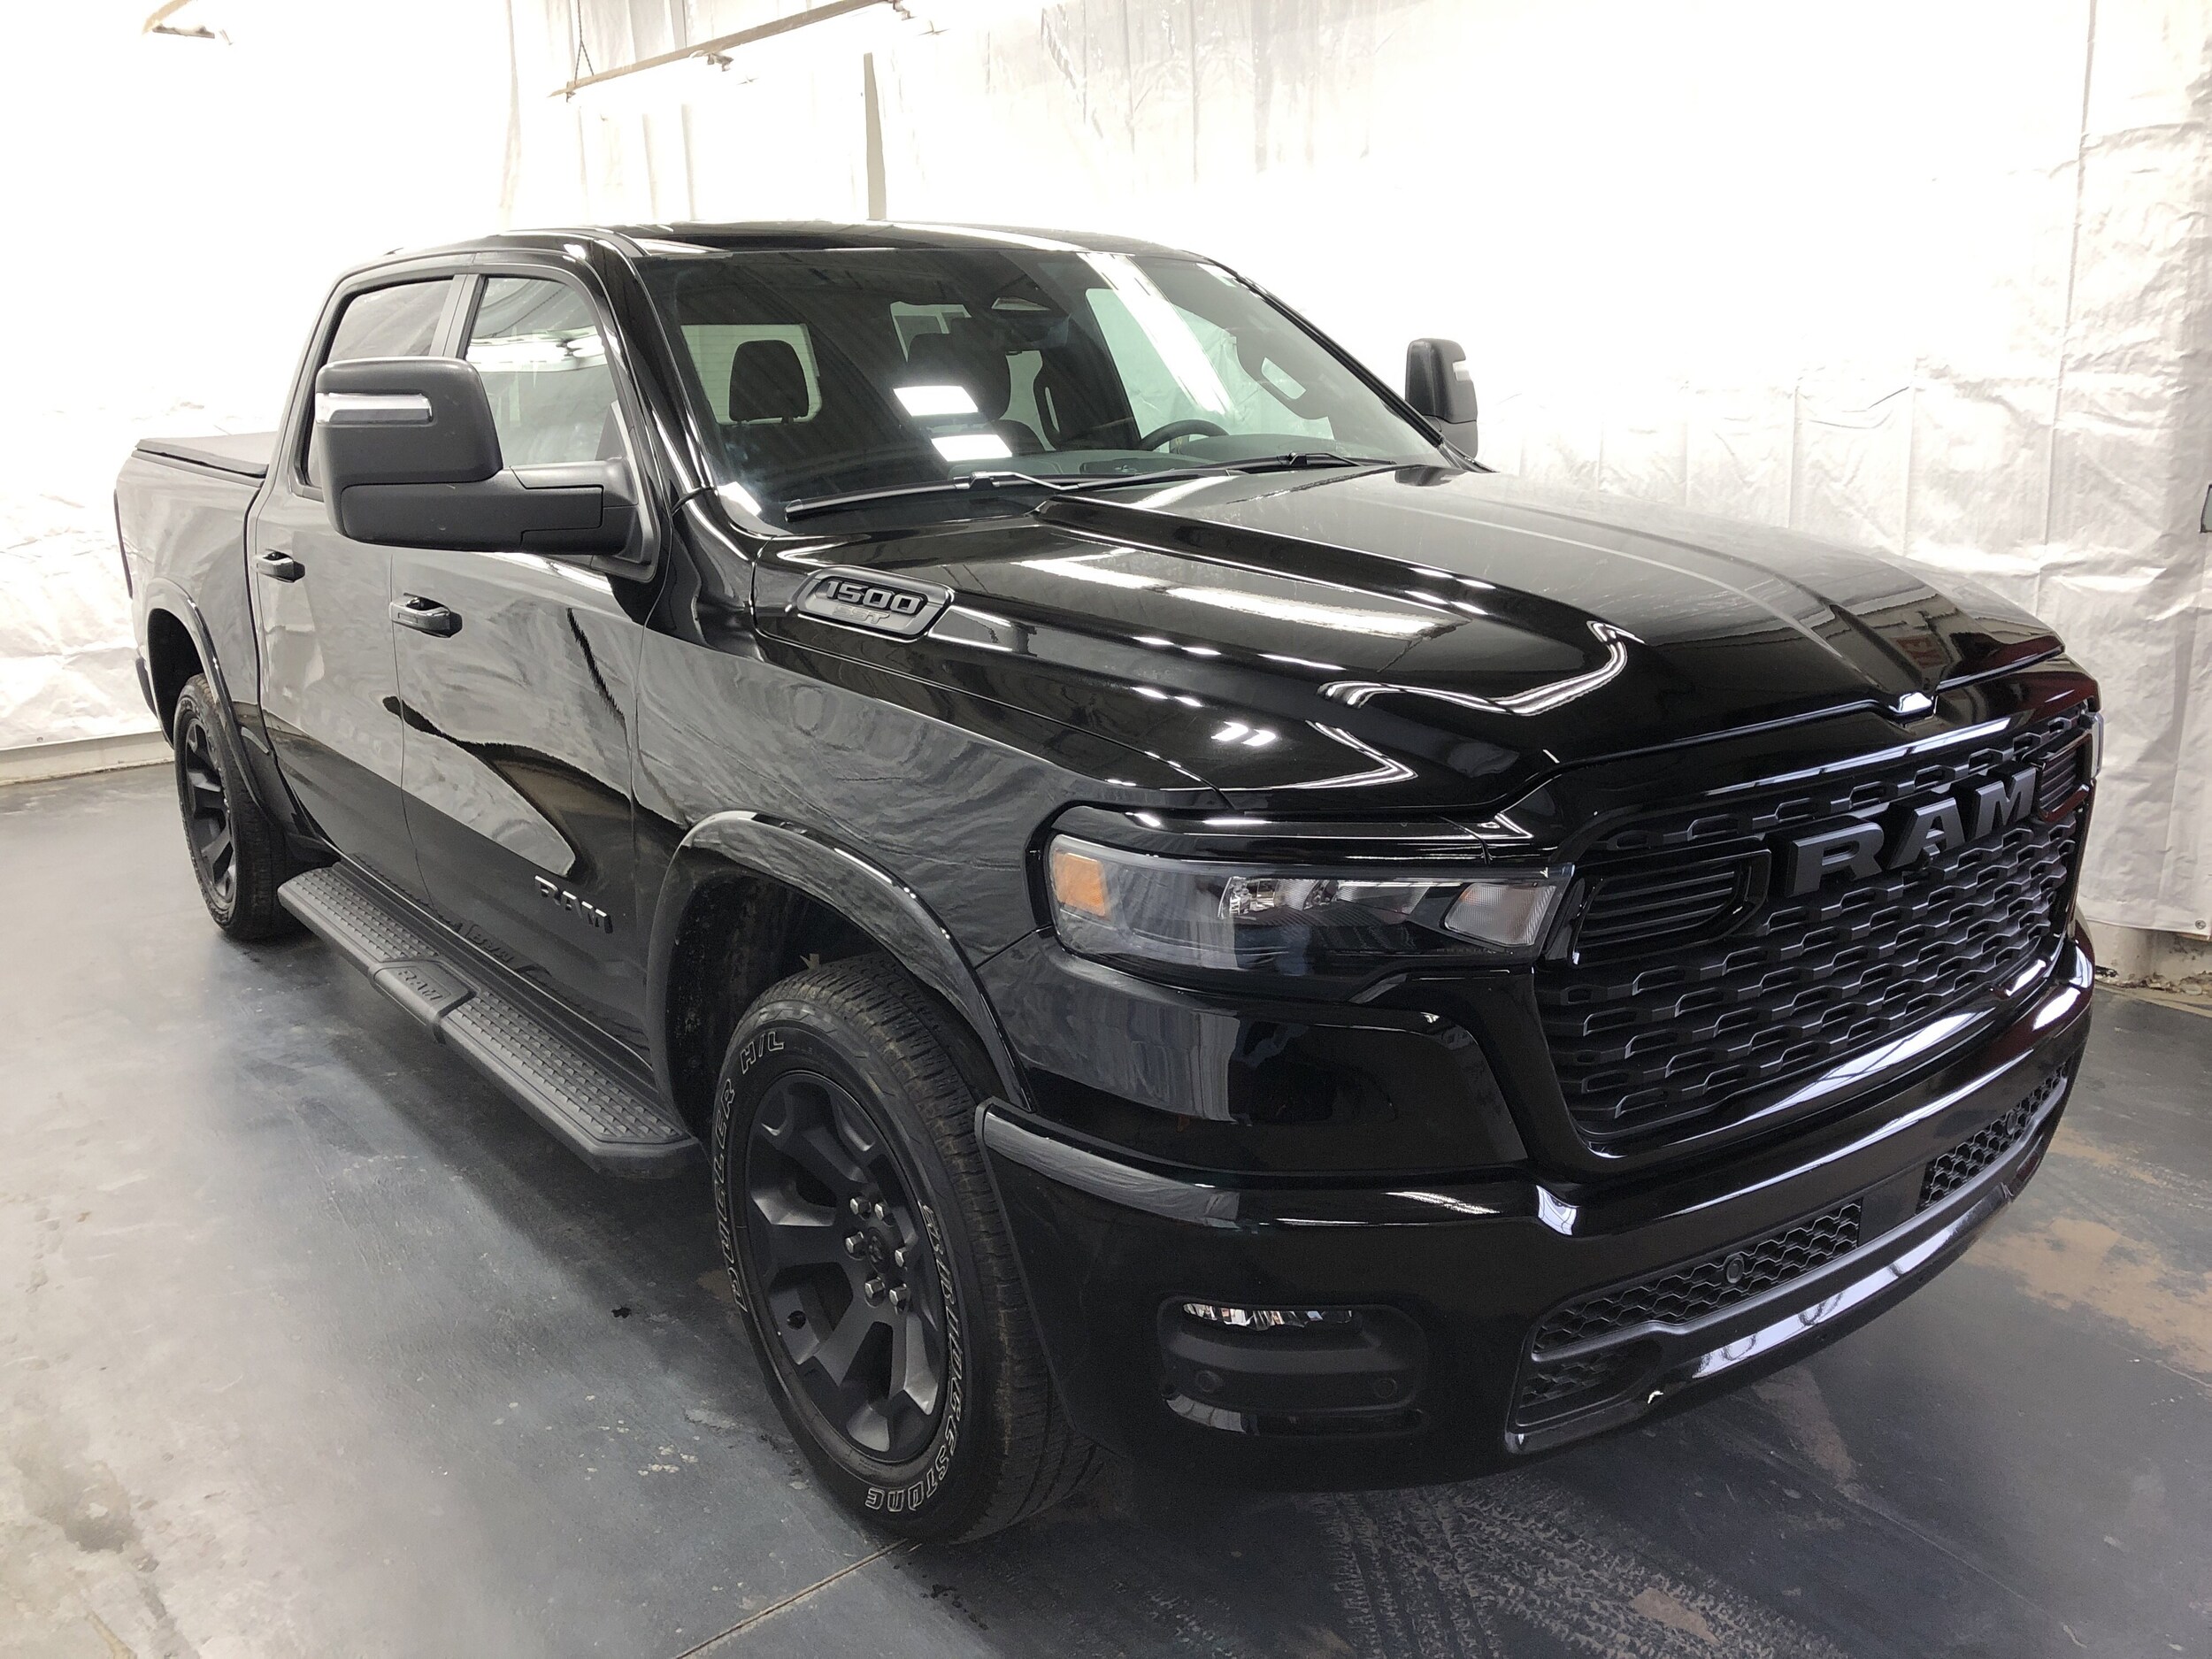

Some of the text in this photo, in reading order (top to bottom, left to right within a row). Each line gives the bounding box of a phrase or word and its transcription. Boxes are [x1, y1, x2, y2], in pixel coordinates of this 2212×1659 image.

[826, 580, 926, 615] 1500
[1787, 765, 2037, 897] RAM
[534, 874, 614, 934] RAM
[397, 970, 444, 1002] RAM
[713, 1030, 786, 1313] DUELER H/L
[864, 1199, 964, 1512] BRIDGESTONE
